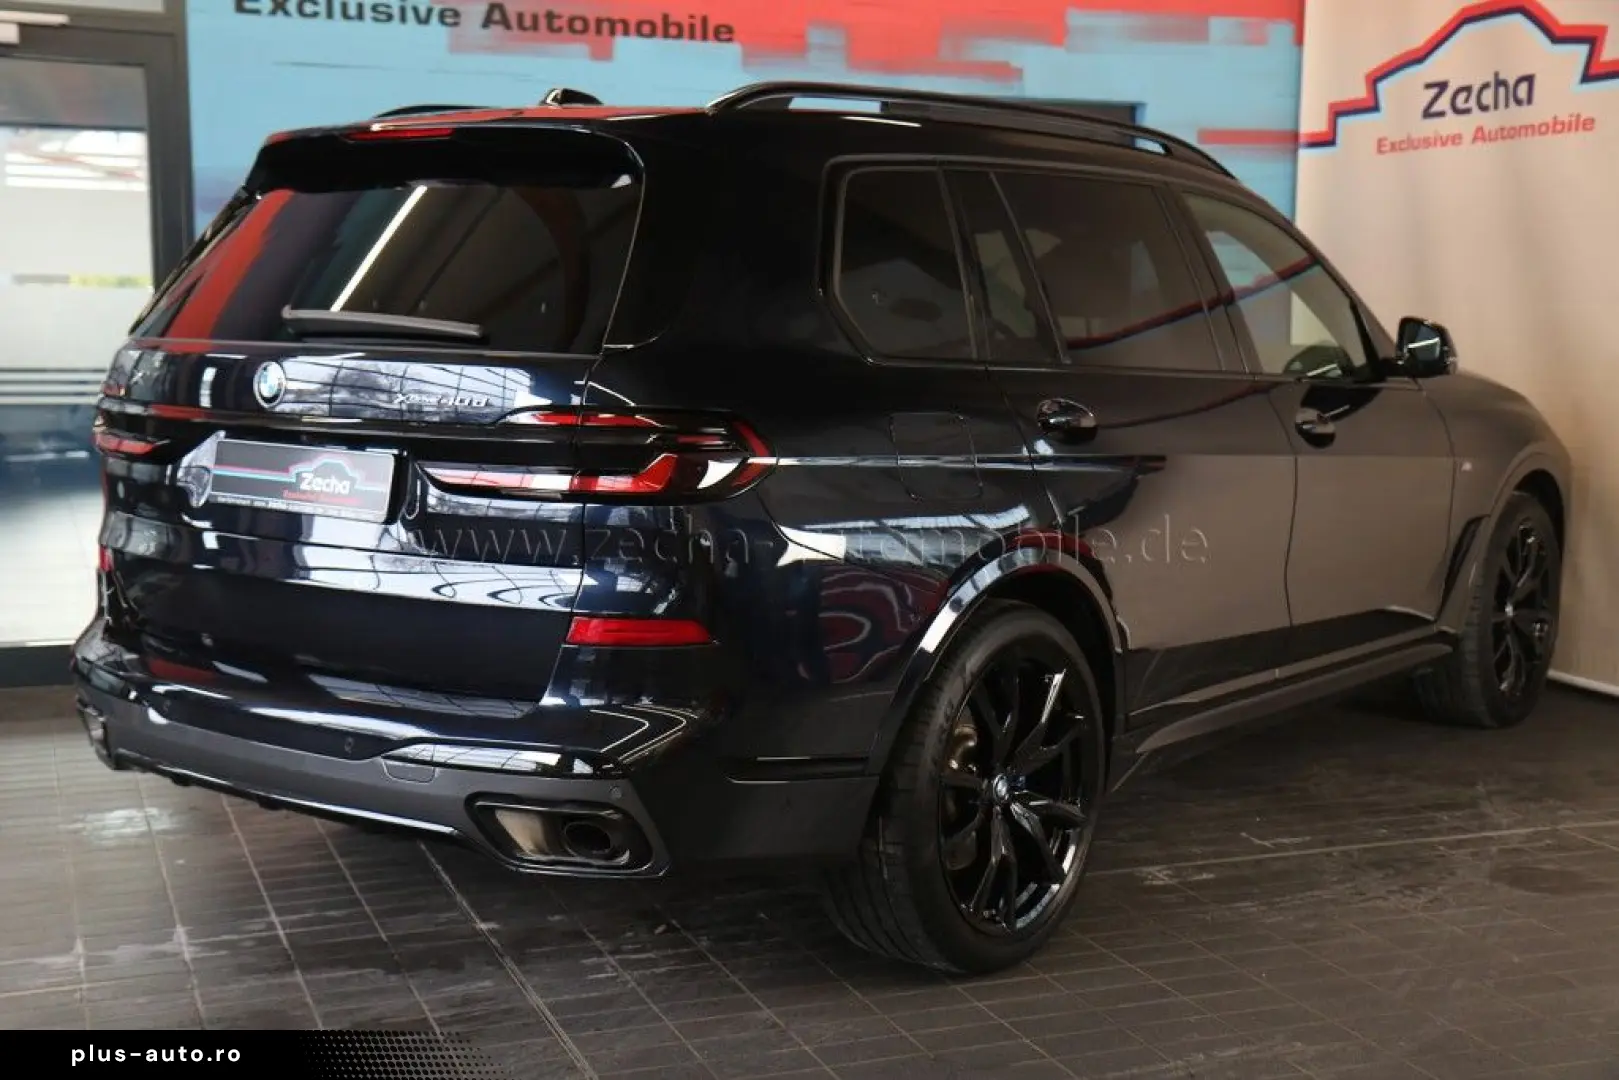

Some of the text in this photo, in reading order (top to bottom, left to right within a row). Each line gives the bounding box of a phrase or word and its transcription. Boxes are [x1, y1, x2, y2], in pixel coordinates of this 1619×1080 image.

[233, 0, 735, 42] Exclusive Automobile
[1421, 71, 1536, 120] Zecha
[1376, 113, 1596, 155] Exclusive Automobile
[299, 472, 351, 495] Zecha
